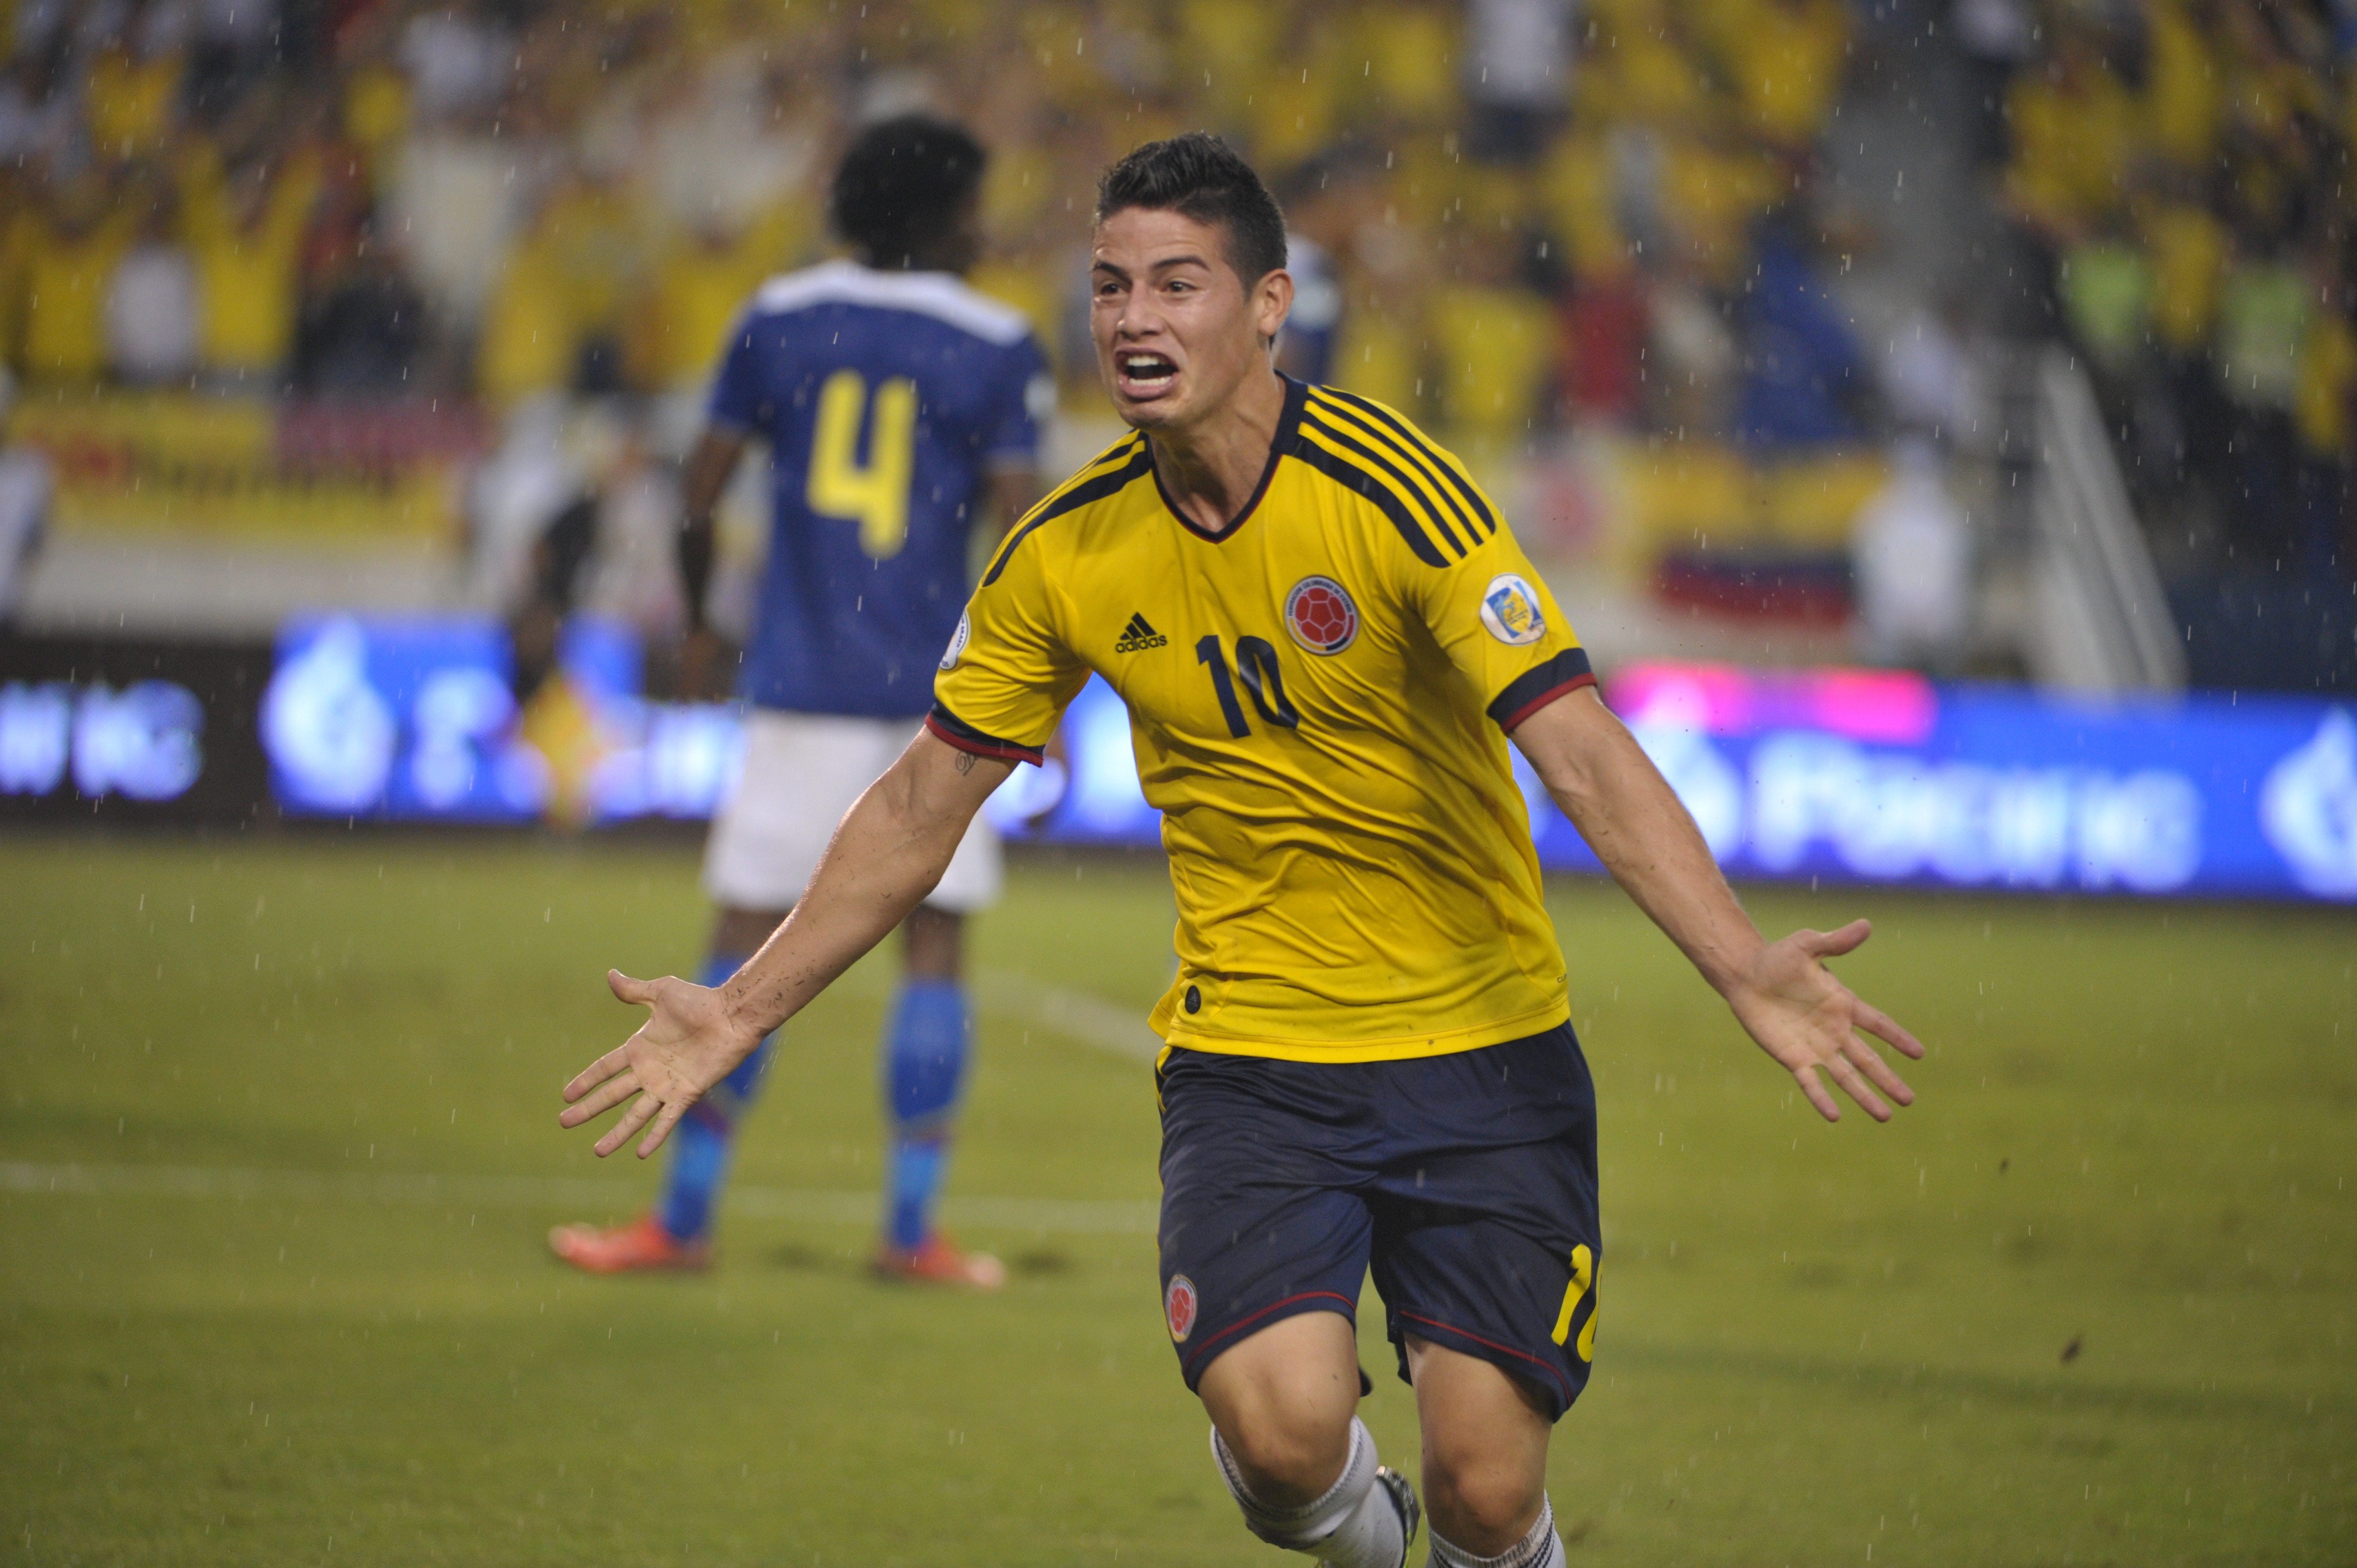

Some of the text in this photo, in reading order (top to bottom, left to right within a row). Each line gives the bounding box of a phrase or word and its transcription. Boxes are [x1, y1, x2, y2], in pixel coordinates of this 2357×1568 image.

[806, 368, 918, 558] 4
[1115, 635, 1167, 653] adidas
[1196, 635, 1300, 739] 10
